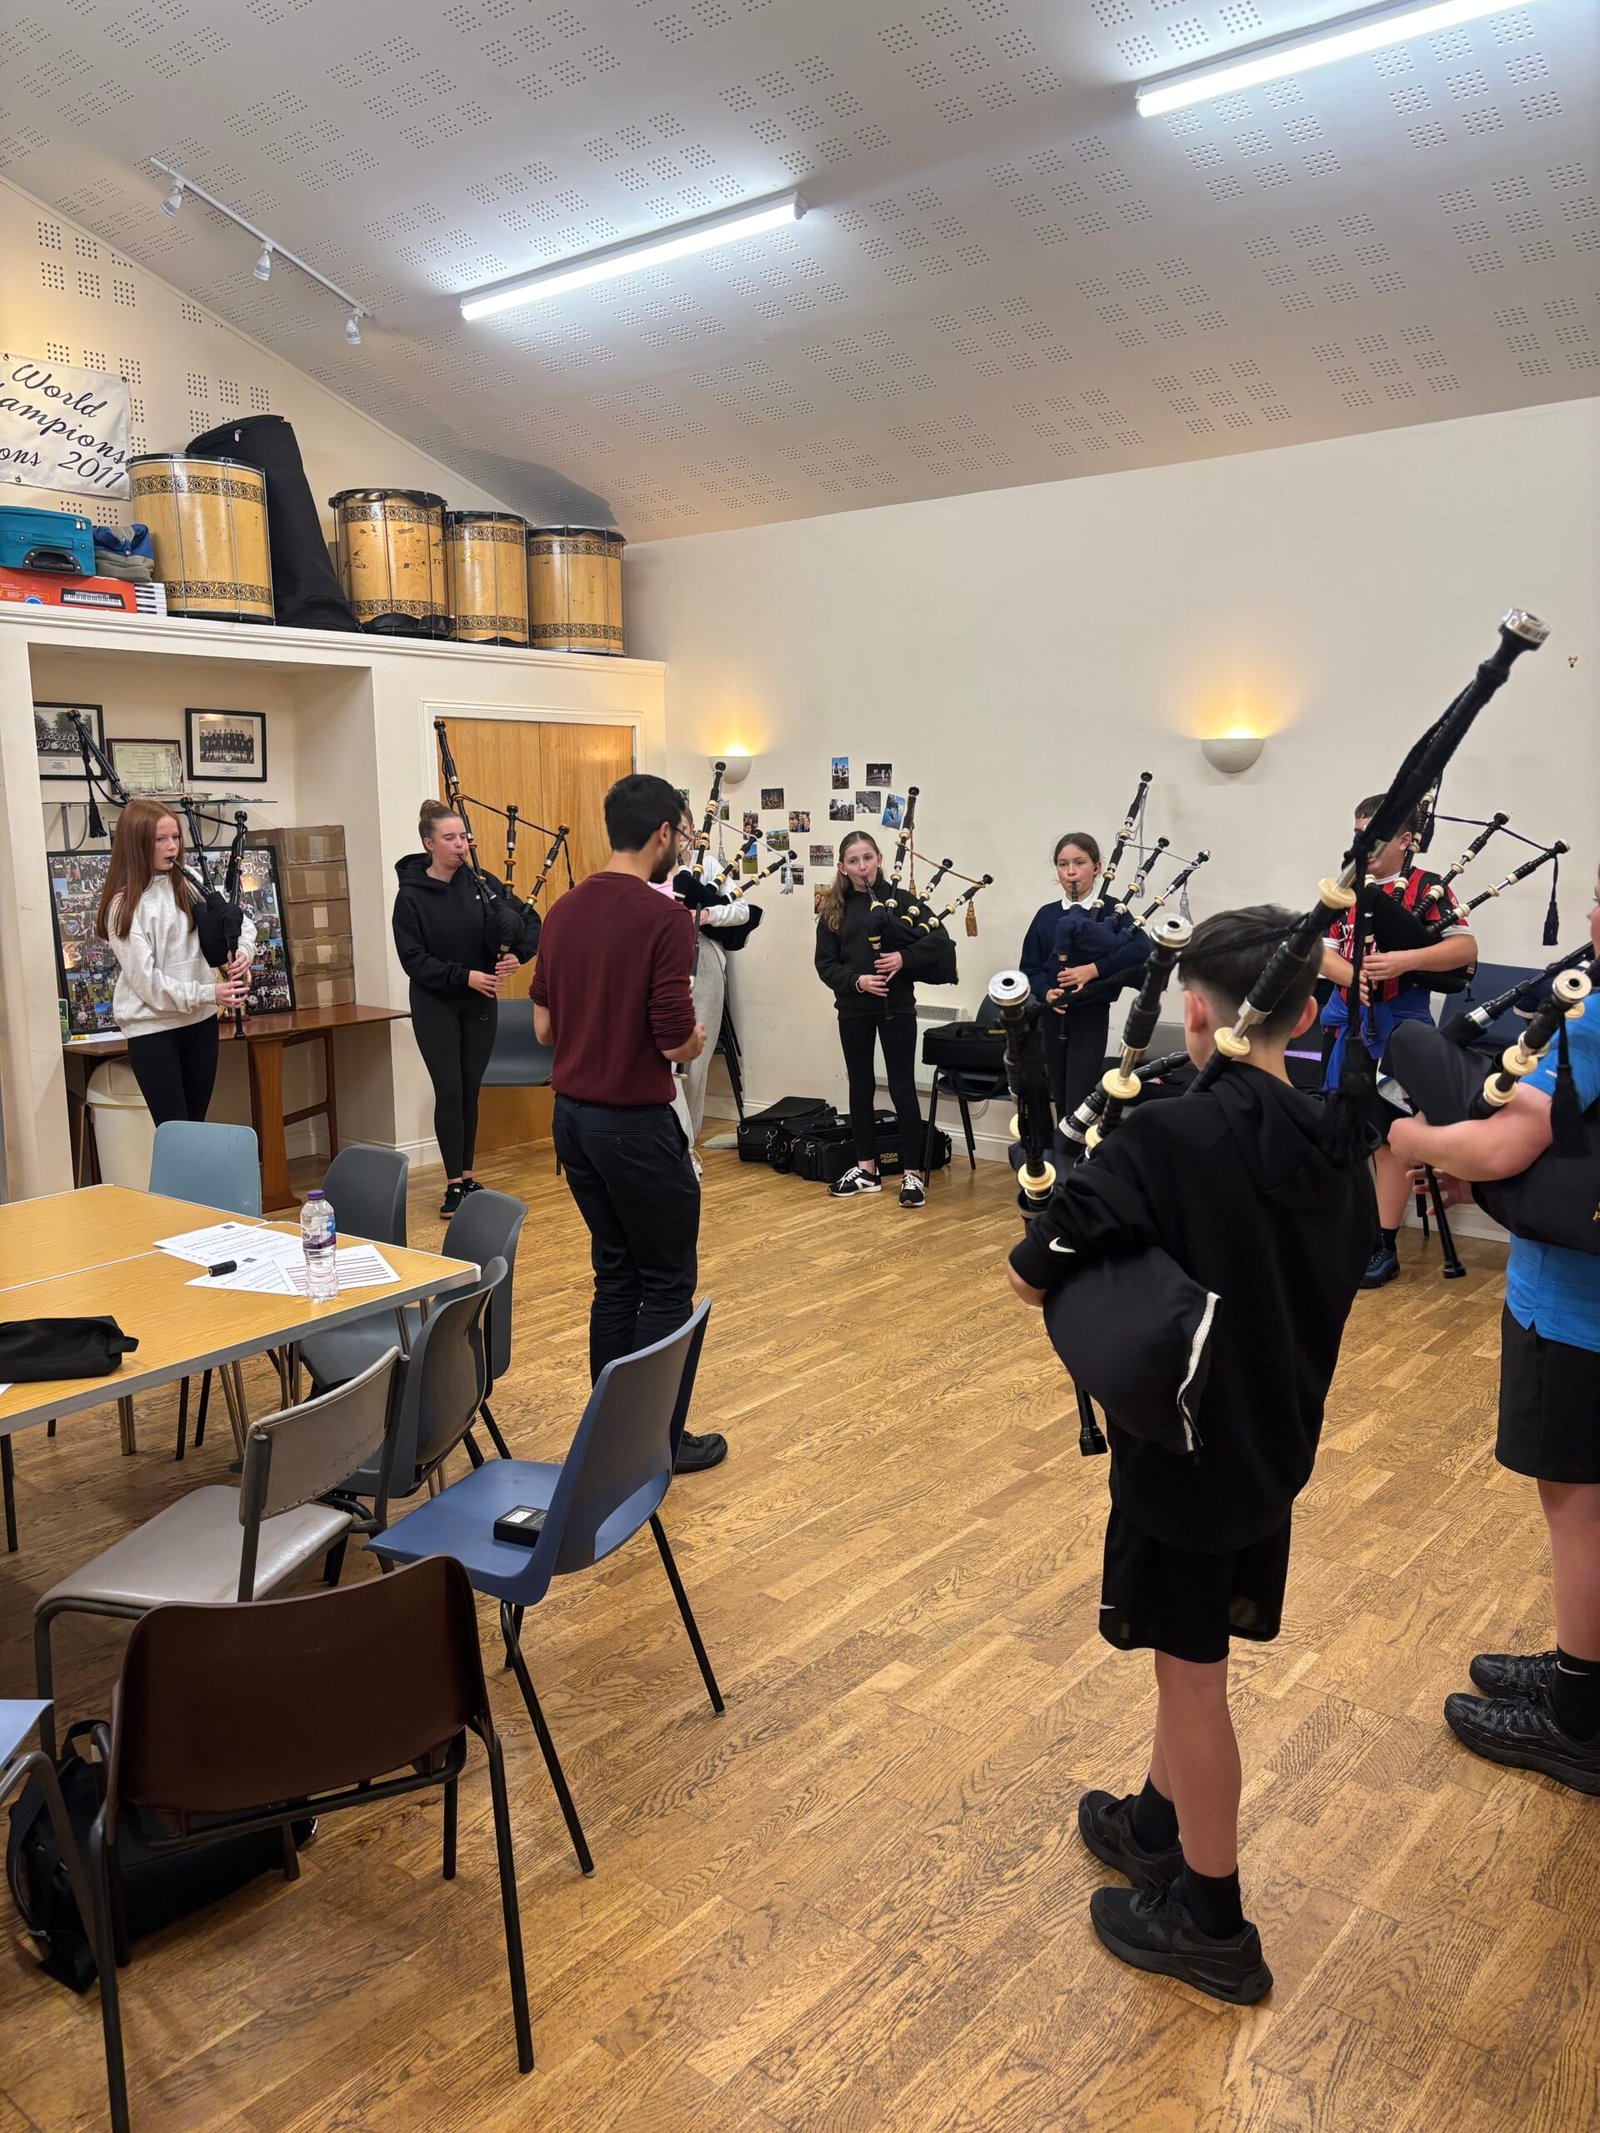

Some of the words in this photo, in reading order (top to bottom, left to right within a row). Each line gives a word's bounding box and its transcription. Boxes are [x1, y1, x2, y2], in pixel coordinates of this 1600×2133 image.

[11, 363, 108, 419] World
[0, 382, 129, 465] ampions
[58, 451, 125, 489] 2011
